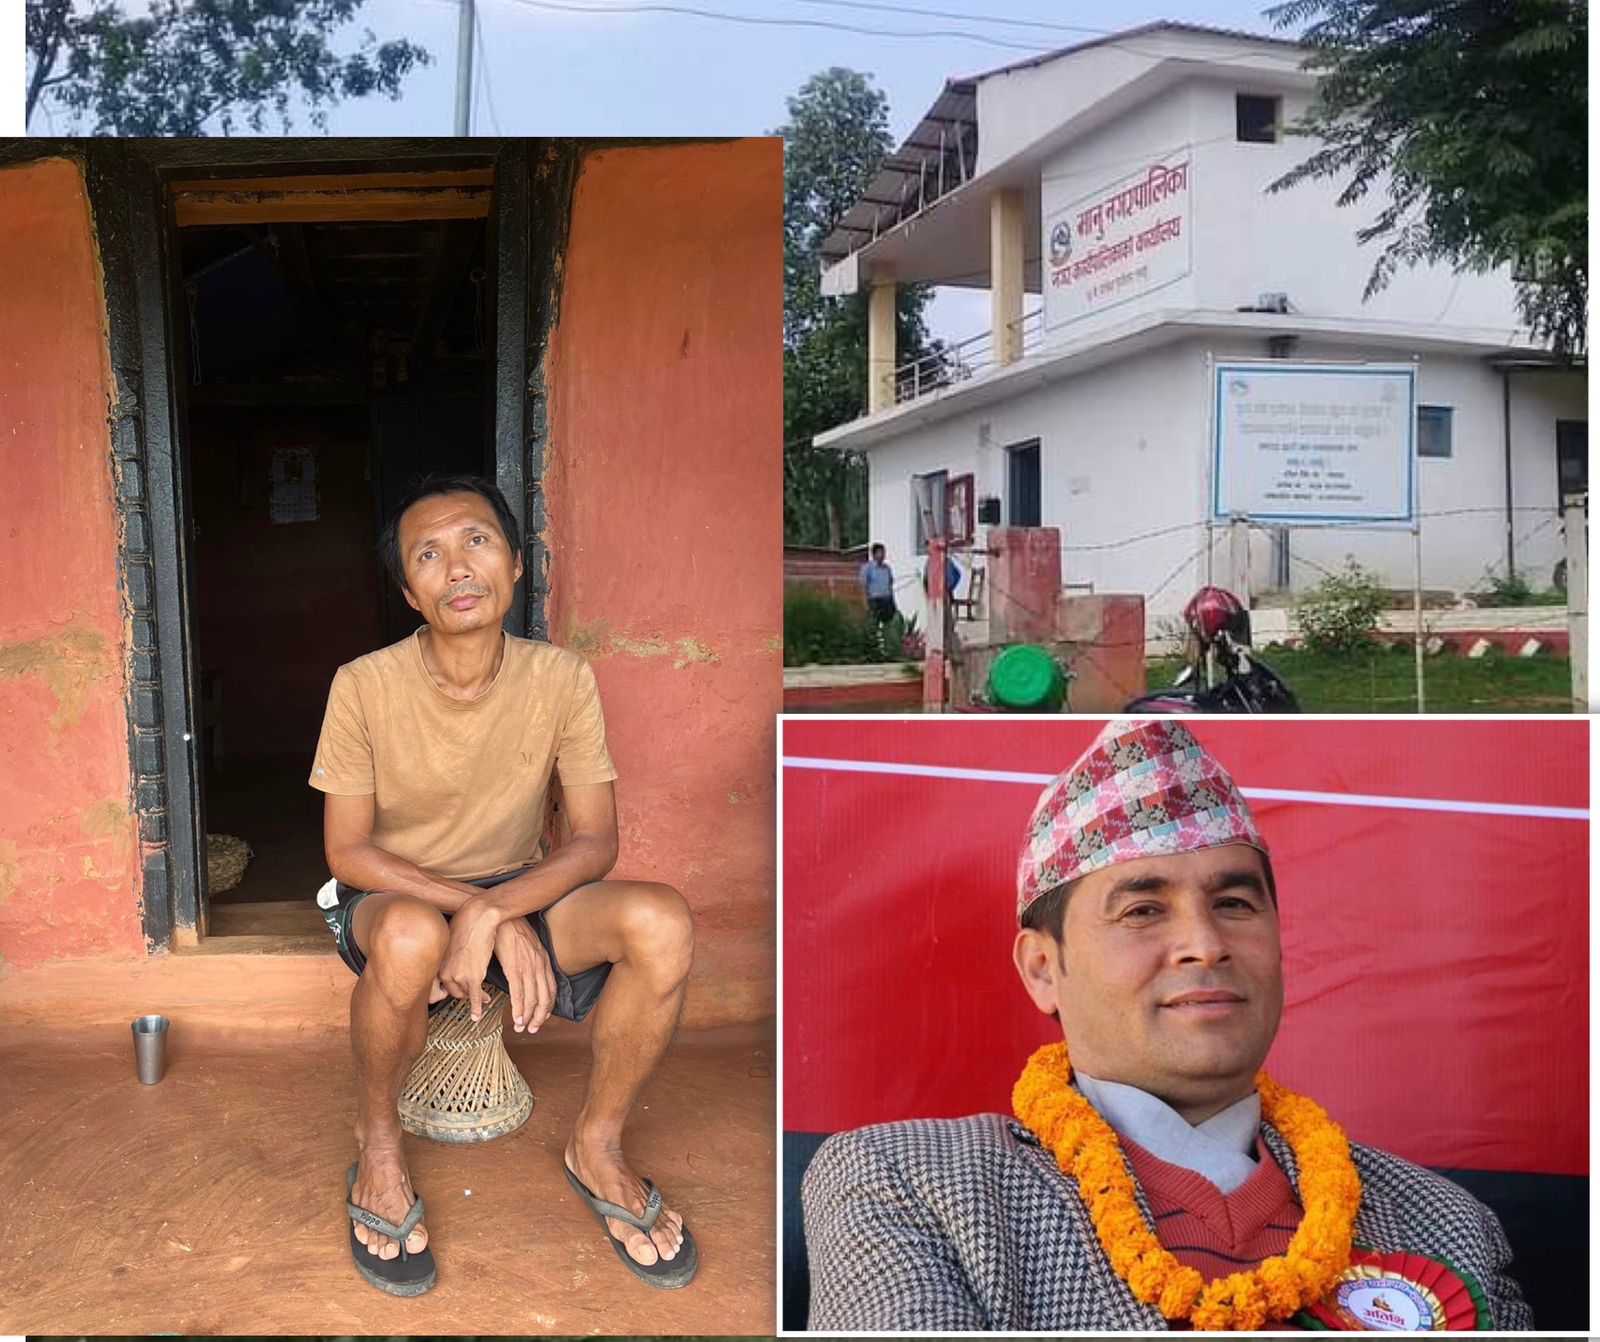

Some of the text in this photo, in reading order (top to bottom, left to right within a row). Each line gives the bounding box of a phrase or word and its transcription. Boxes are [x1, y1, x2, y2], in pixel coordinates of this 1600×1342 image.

[1104, 162, 1190, 222] नगरपालिका
[360, 1211, 381, 1226] Hippo
[1363, 1308, 1405, 1325] अतिथि
